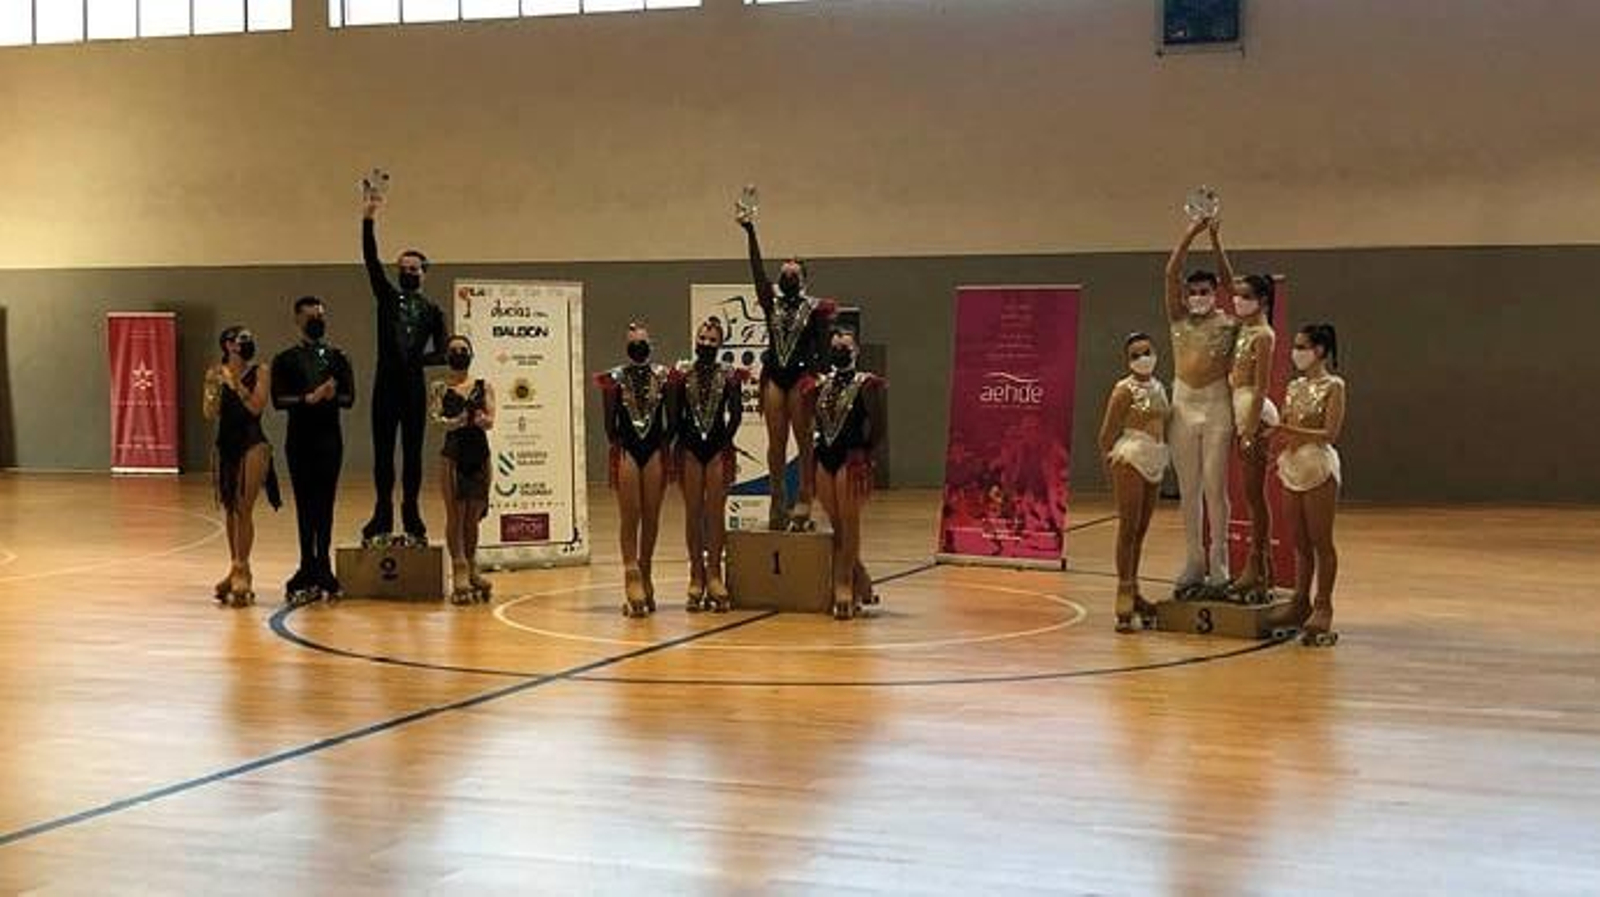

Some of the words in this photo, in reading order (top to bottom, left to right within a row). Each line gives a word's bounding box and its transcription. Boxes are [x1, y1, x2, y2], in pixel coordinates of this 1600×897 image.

[980, 383, 1043, 404] aehde
[380, 557, 398, 580] 2
[772, 551, 781, 575] 1
[1195, 608, 1213, 635] 3
